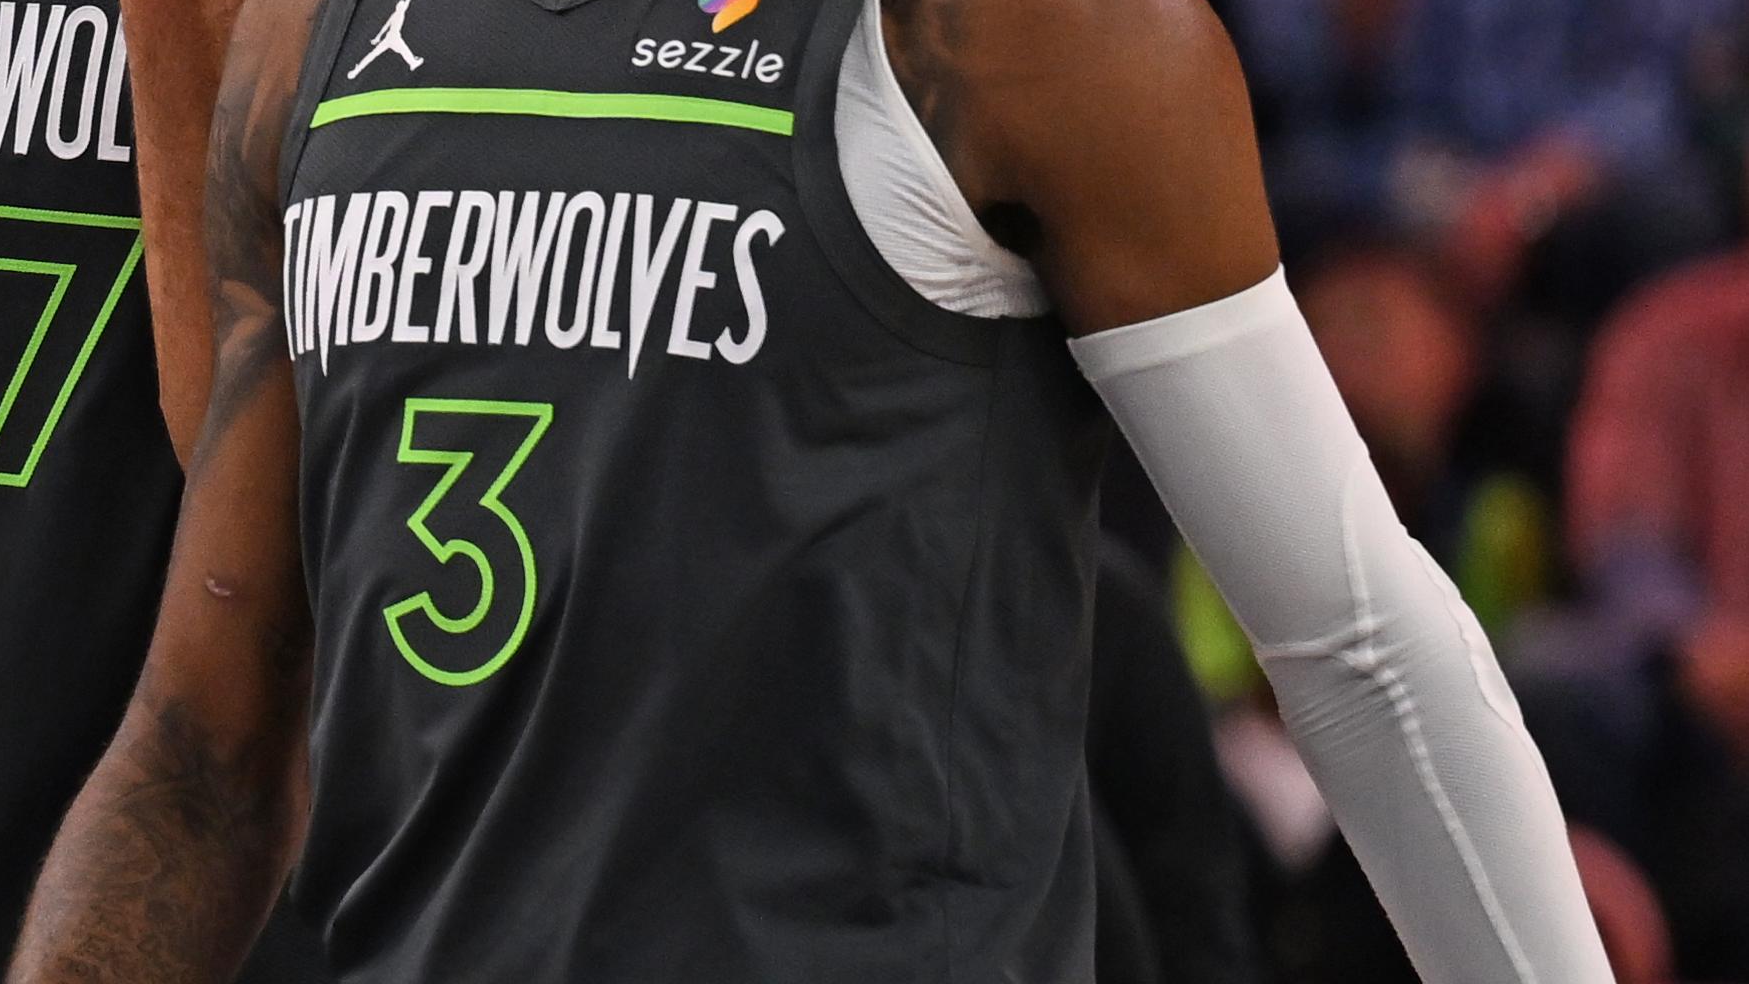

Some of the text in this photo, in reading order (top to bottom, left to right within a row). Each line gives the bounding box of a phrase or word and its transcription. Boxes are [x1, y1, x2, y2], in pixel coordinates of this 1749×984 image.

[631, 35, 784, 83] sezzle
[284, 190, 786, 380] TIMBERWOLVES
[383, 398, 553, 686] 3
